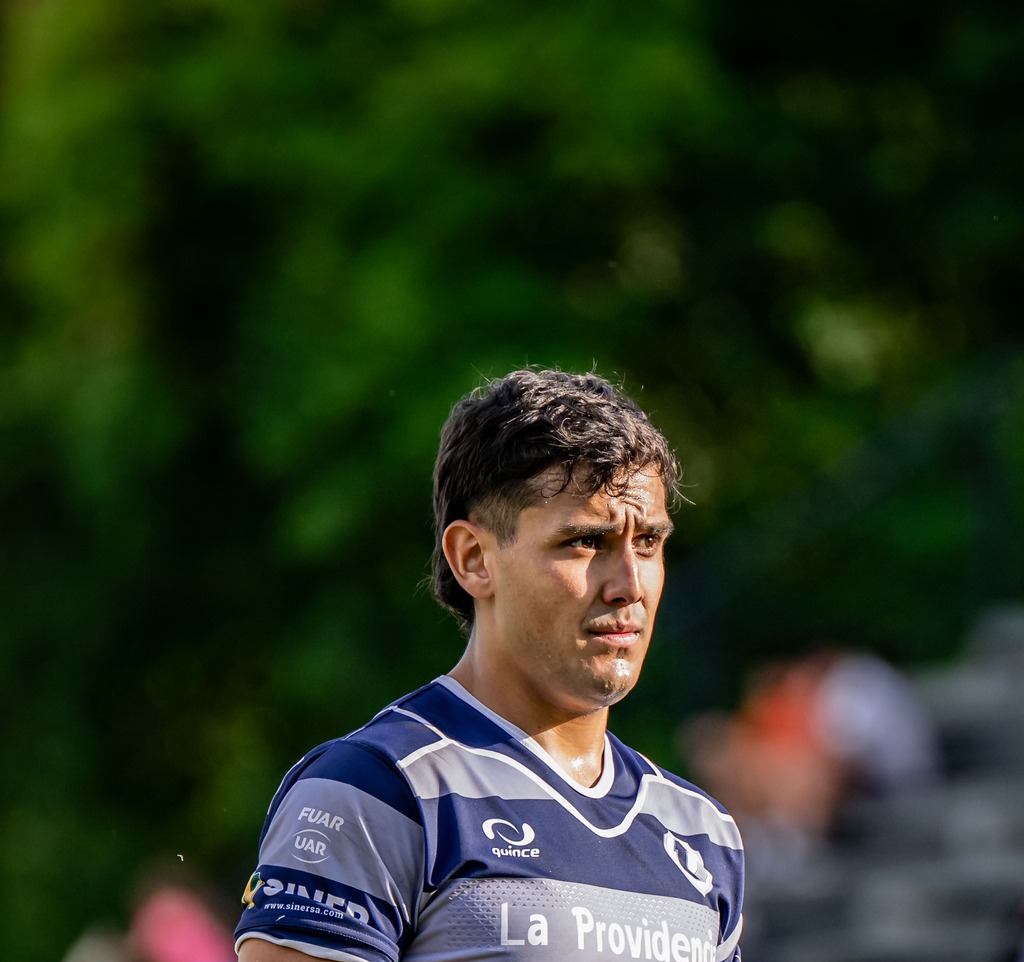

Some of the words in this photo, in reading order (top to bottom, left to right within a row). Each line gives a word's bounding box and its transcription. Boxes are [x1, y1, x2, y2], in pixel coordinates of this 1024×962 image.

[297, 807, 345, 831] FUAR
[294, 836, 327, 856] UAR
[492, 845, 540, 858] quince
[264, 902, 344, 919] www.sinersa.com
[501, 902, 548, 946] La
